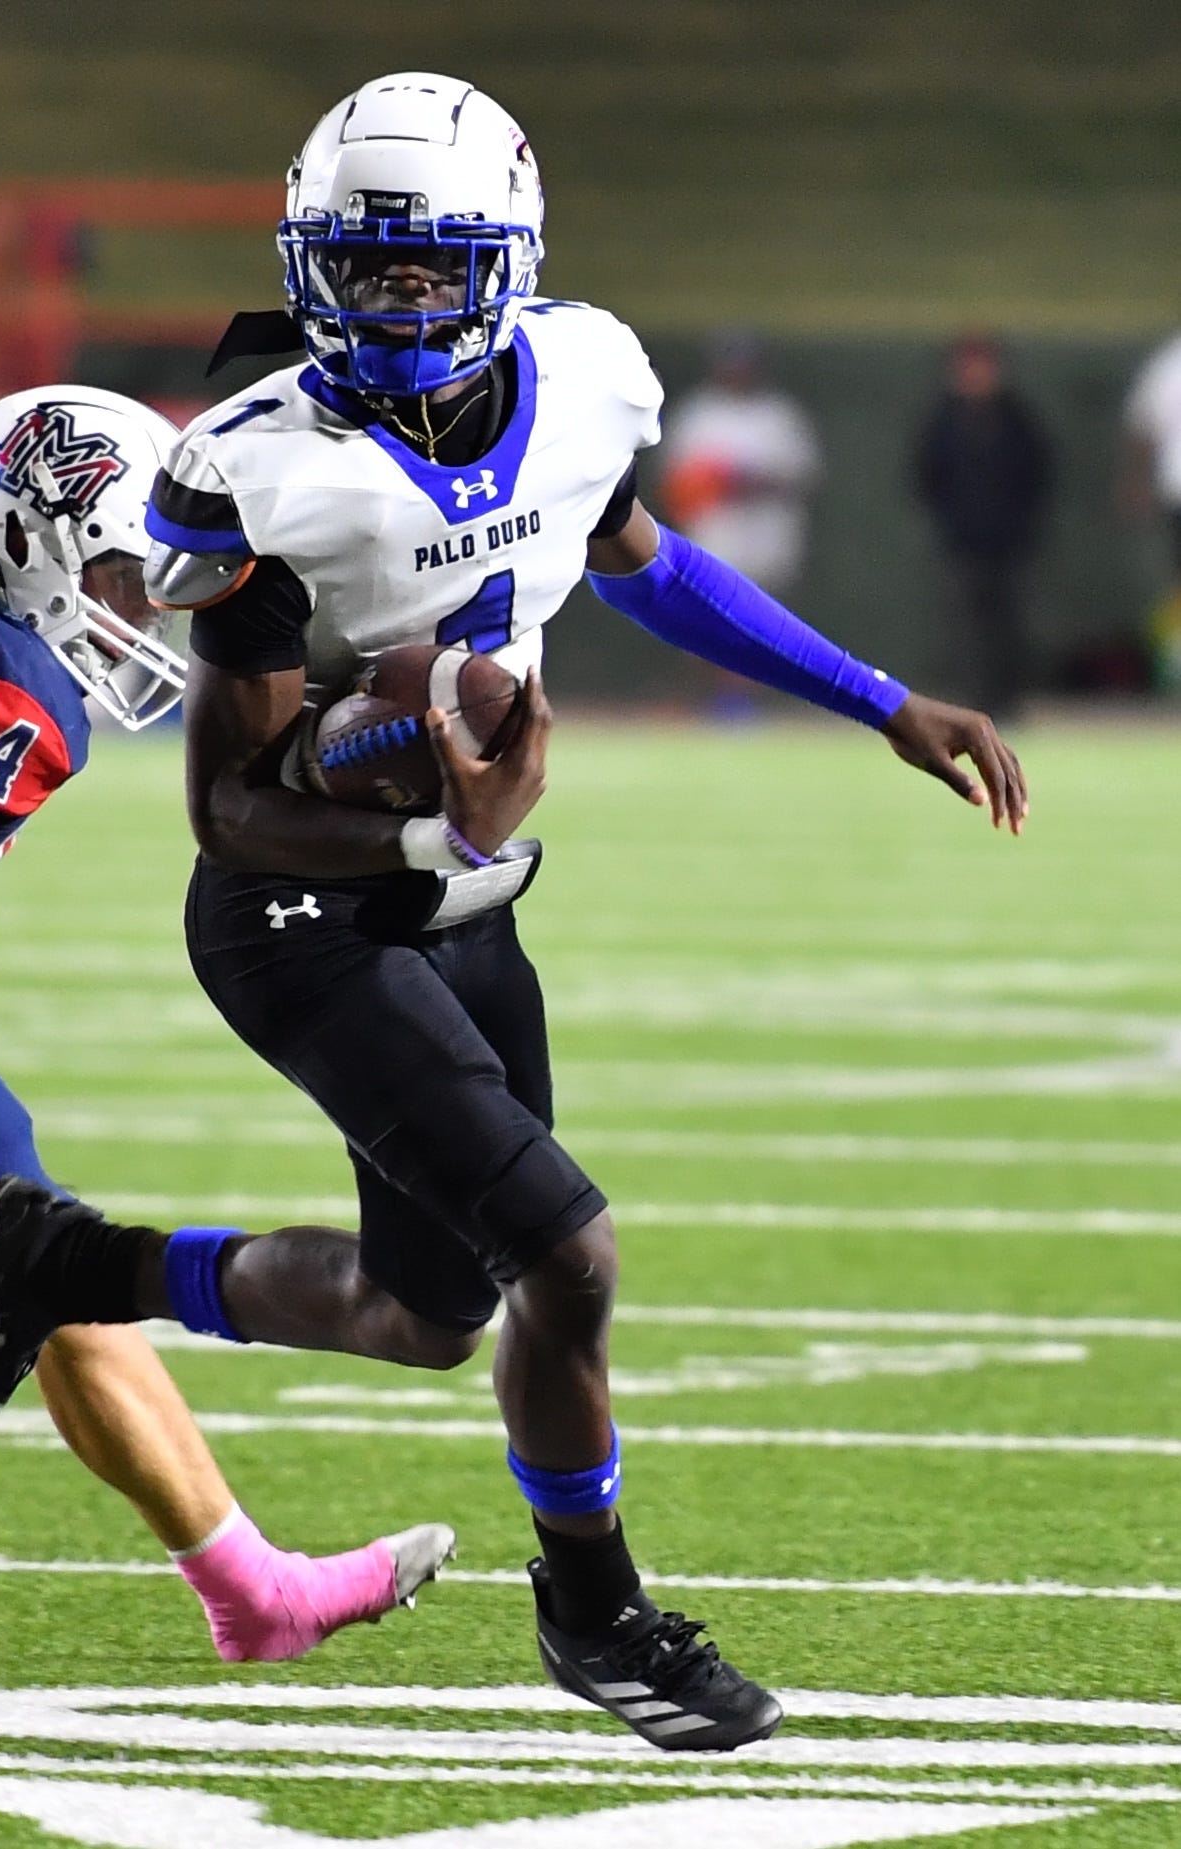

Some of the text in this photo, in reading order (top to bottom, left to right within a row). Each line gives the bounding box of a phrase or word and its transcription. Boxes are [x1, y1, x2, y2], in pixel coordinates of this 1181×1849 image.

[209, 398, 285, 437] 1
[414, 509, 541, 572] PALO DURO
[435, 567, 516, 655] 1
